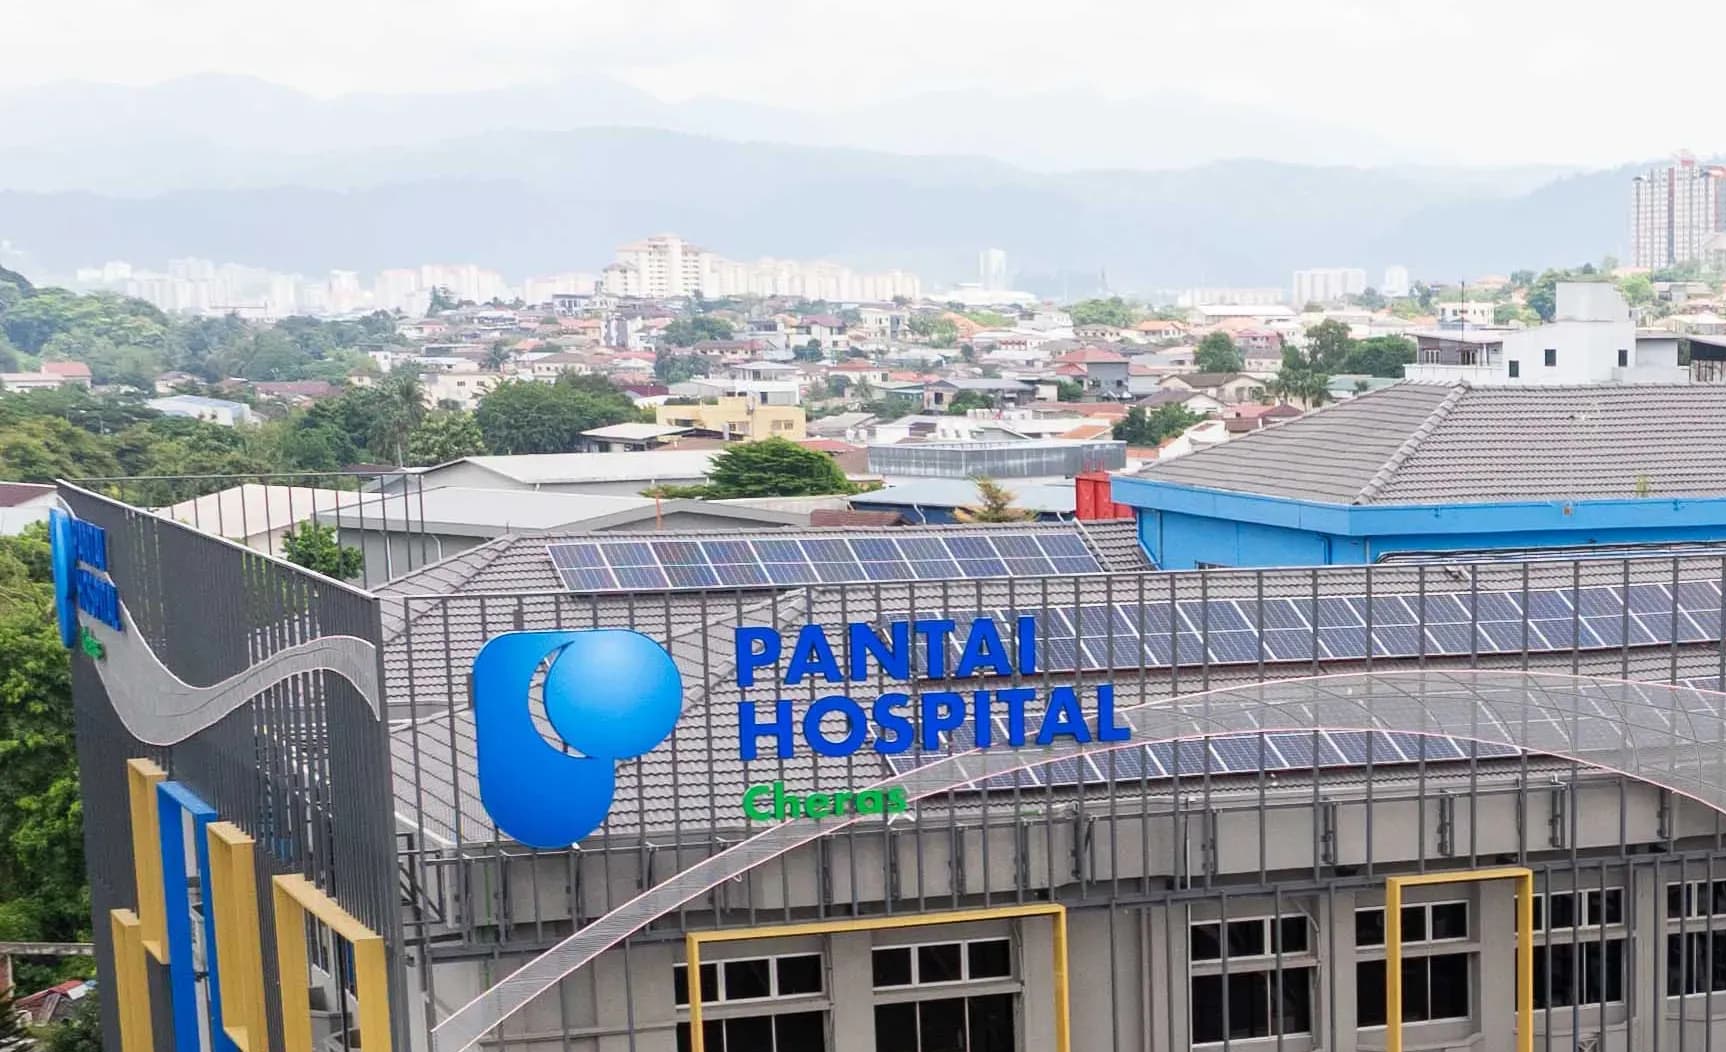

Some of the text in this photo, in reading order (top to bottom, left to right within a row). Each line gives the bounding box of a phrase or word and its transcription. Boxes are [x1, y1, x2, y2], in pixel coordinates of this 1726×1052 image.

[734, 616, 1036, 687] PANTAI
[737, 684, 1132, 761] HOSPITAL
[742, 781, 907, 822] Cheras
